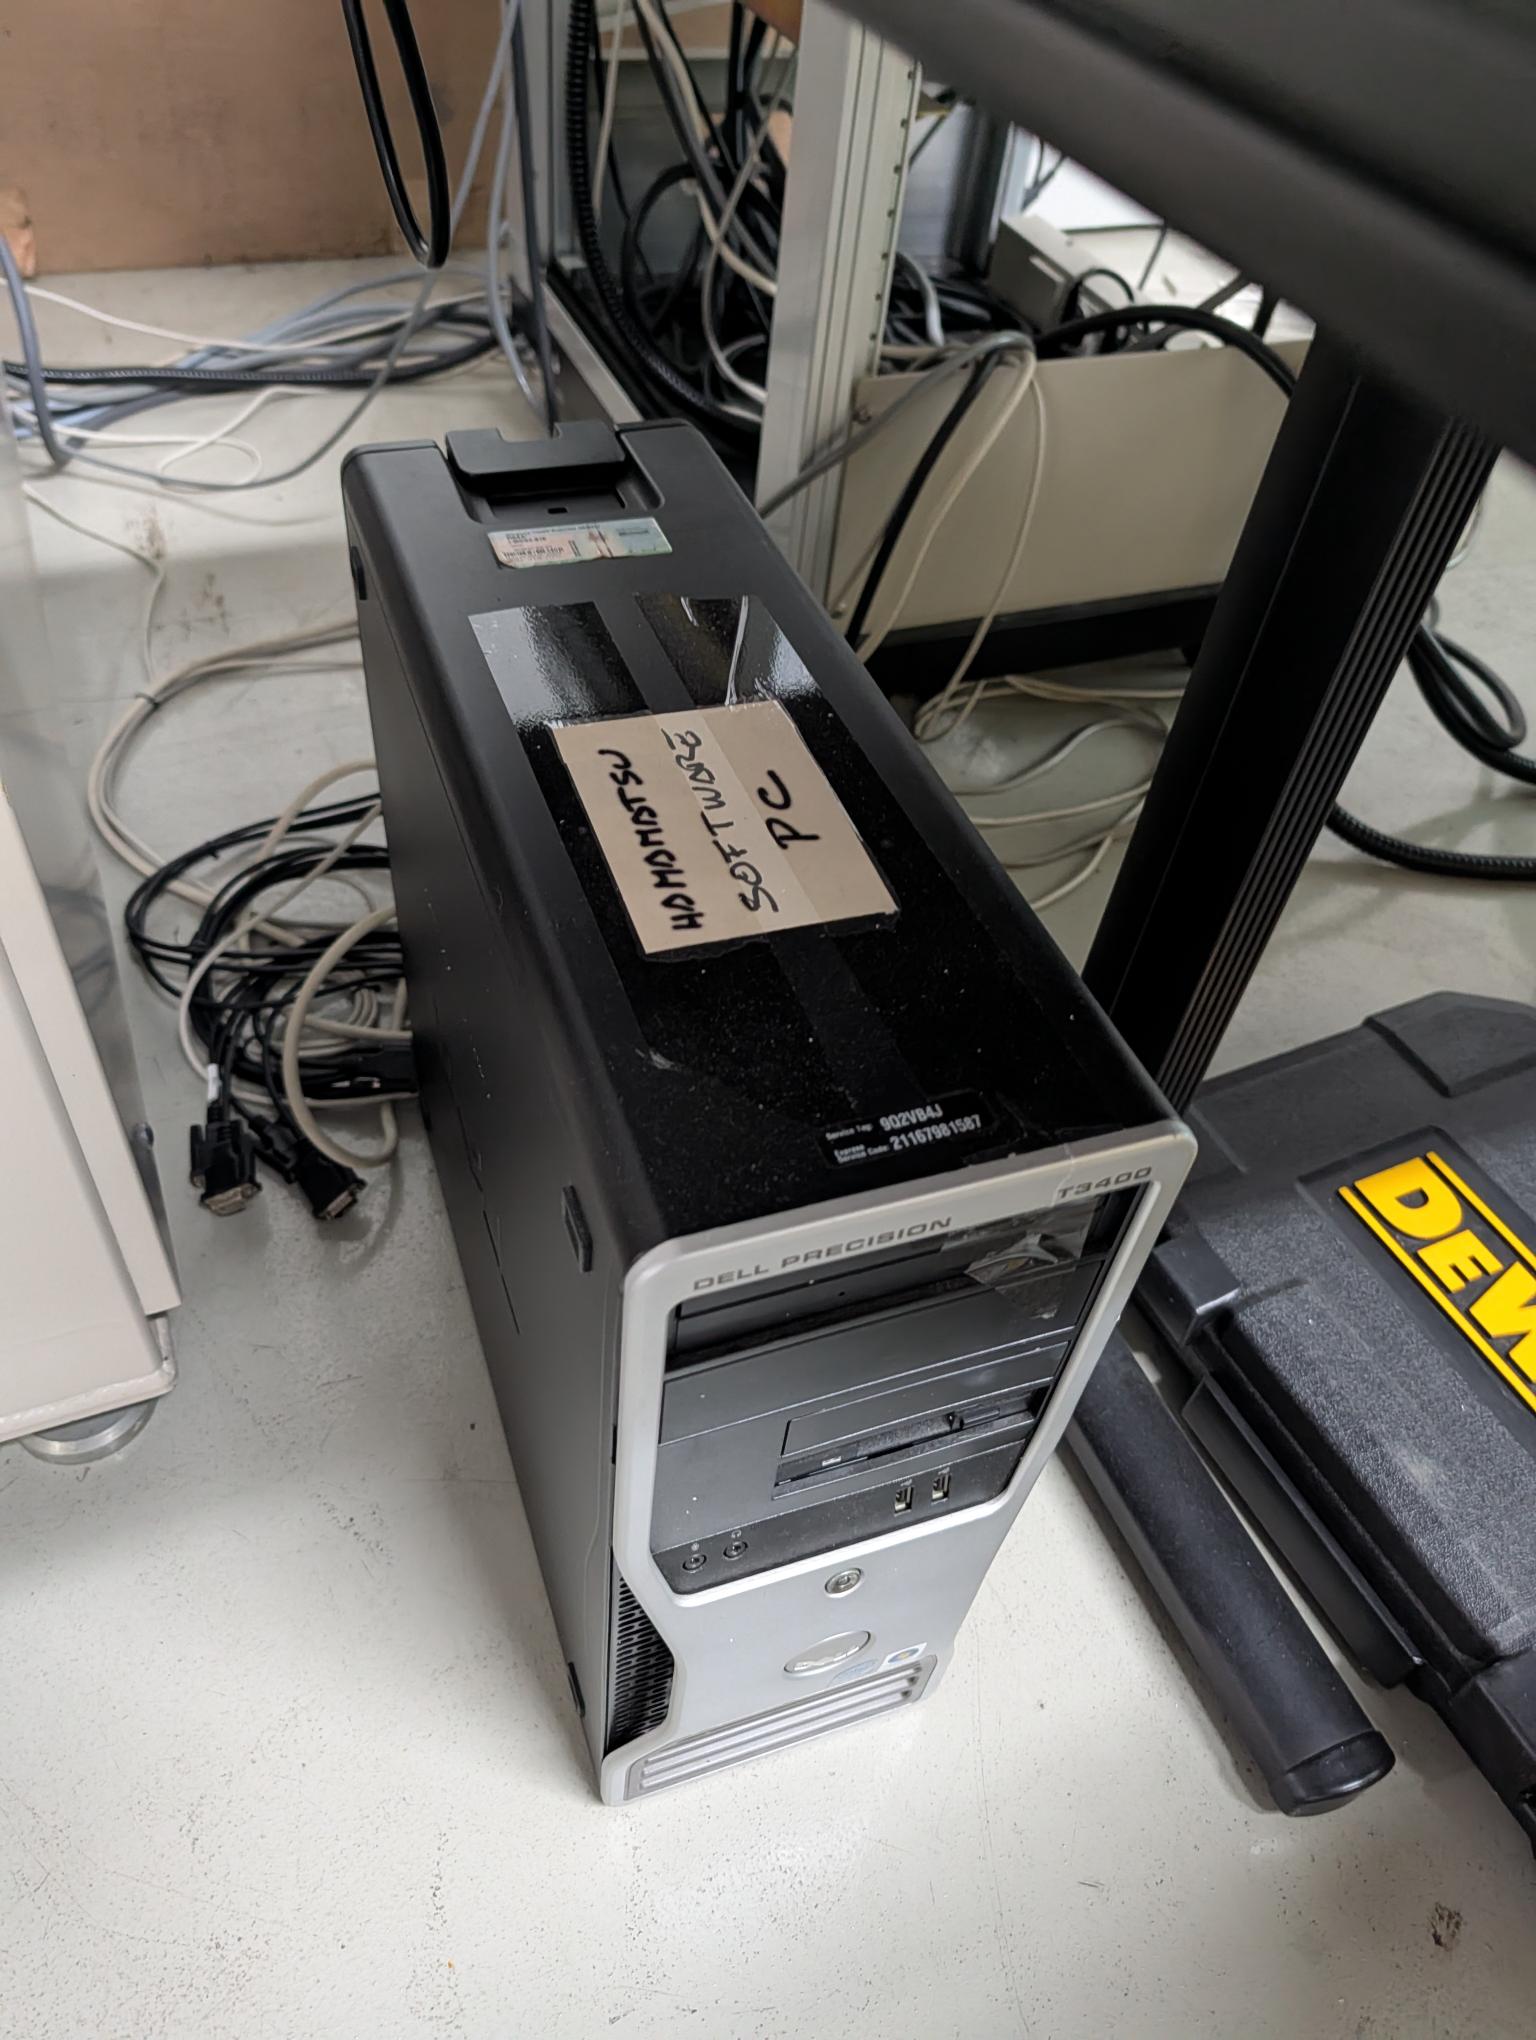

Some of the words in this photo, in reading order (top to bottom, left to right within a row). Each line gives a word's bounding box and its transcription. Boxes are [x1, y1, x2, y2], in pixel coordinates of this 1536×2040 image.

[661, 728, 779, 913] SOFTWARE
[757, 769, 819, 850] PC
[879, 1103, 943, 1132] 9Q2VB4J
[889, 1114, 982, 1151] 21167981587
[1058, 1166, 1153, 1199] T3400
[693, 1263, 771, 1291] DELL
[782, 1216, 953, 1268] PRECISION
